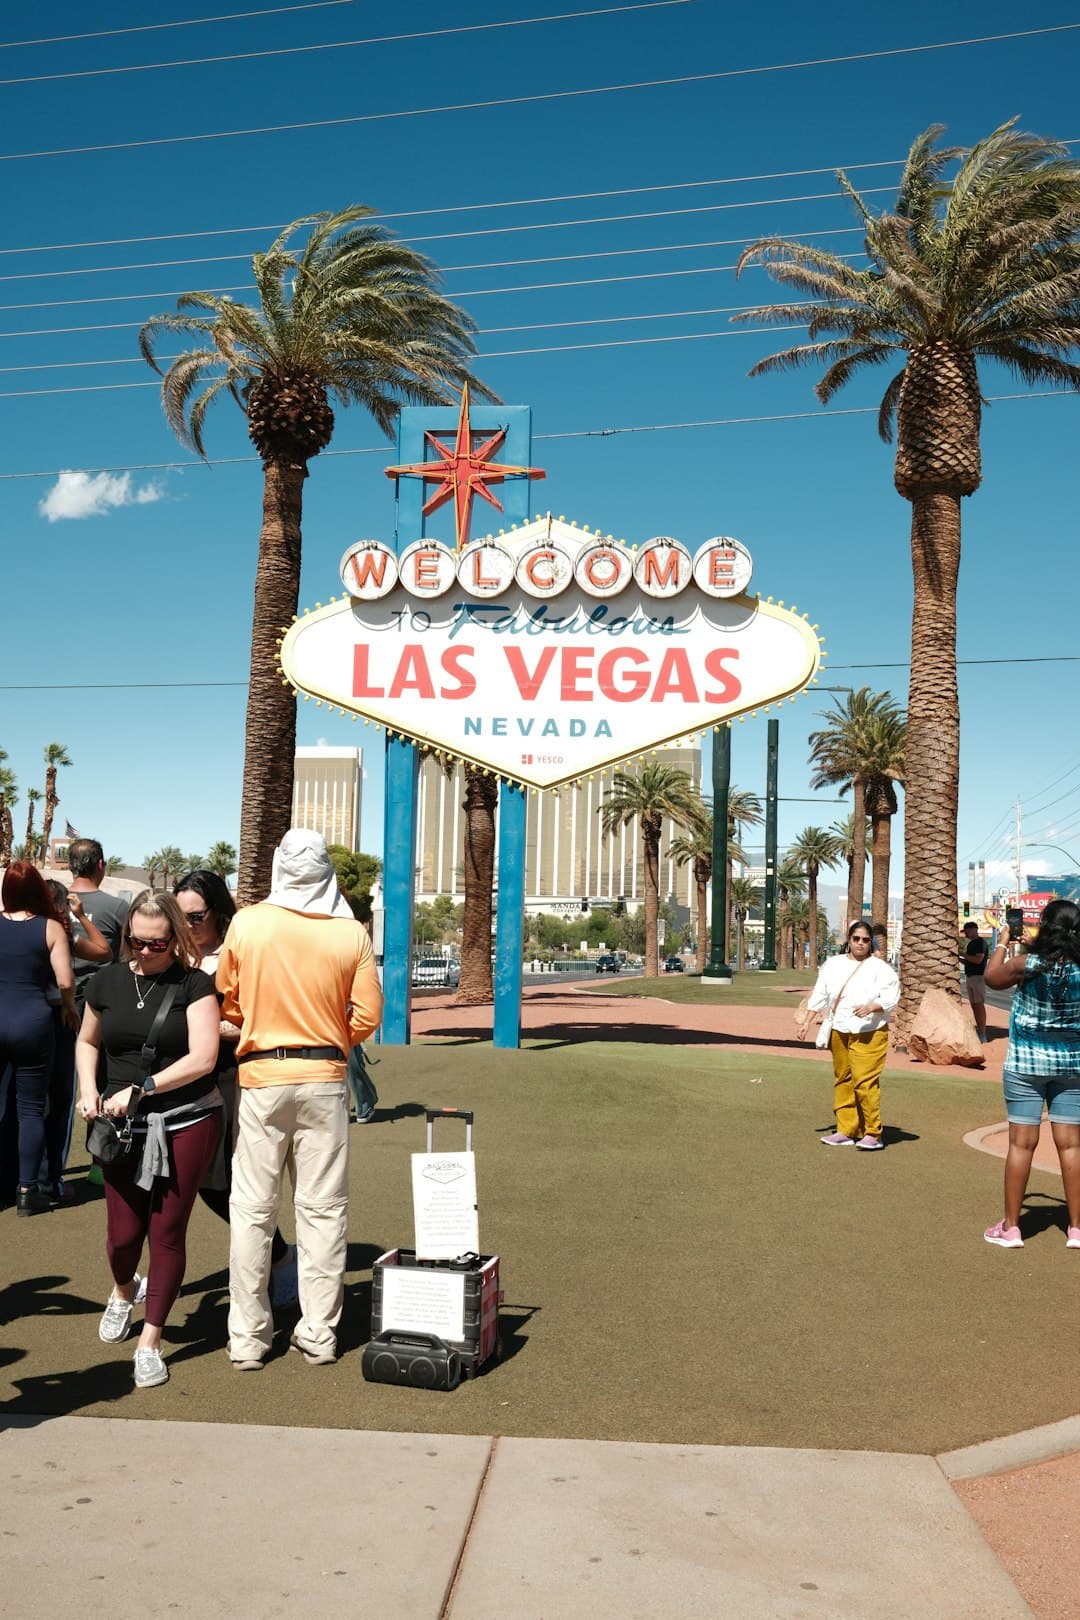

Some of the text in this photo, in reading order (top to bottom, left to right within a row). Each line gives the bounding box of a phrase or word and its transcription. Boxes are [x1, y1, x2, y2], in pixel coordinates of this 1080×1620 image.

[350, 549, 738, 590] WELCOME
[391, 603, 692, 639] TO Fabulous
[352, 643, 742, 705] LAS VEGAS
[464, 717, 613, 738] NEVADA
[536, 756, 564, 764] YESCO
